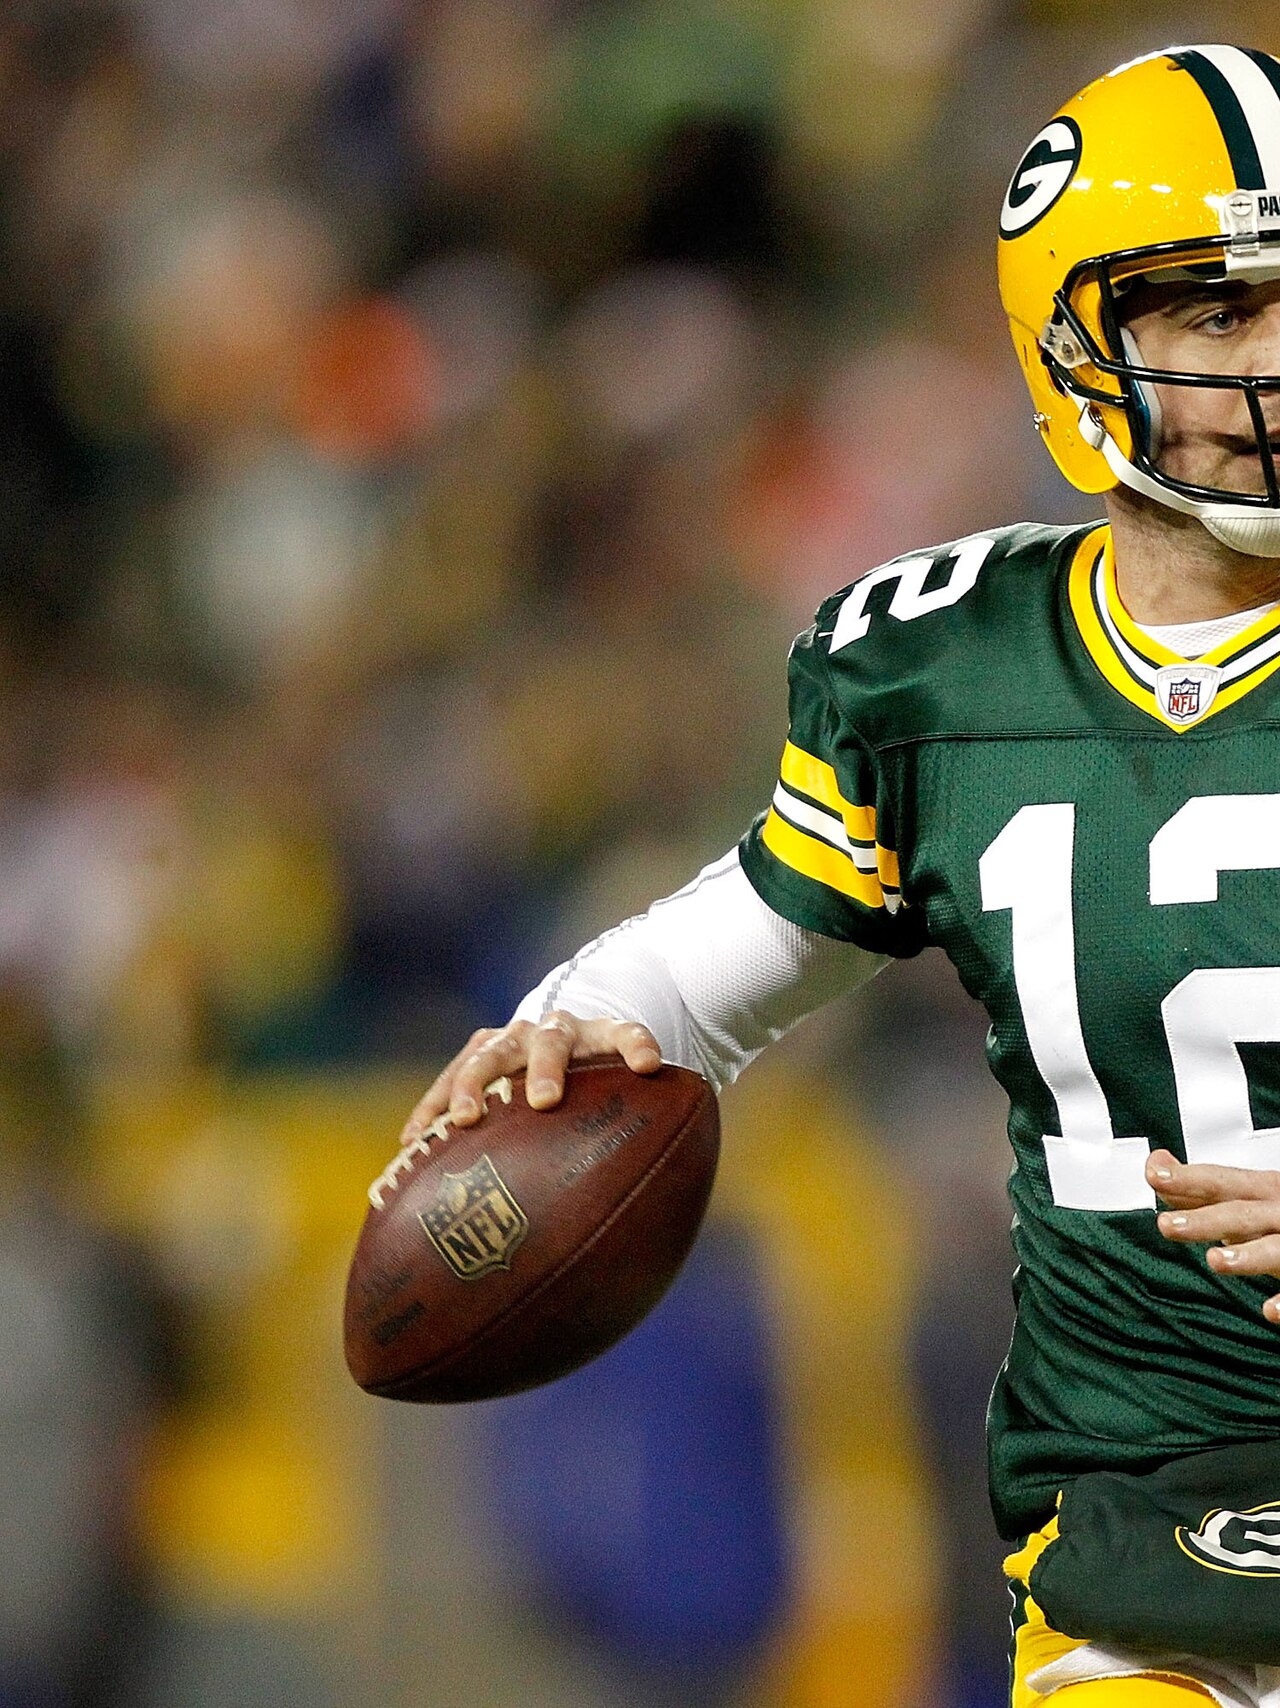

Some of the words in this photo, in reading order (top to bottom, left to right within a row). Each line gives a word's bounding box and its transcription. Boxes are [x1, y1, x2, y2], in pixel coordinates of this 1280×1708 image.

[1000, 121, 1080, 234] G
[1170, 694, 1196, 713] NFL
[445, 1200, 516, 1269] NFL
